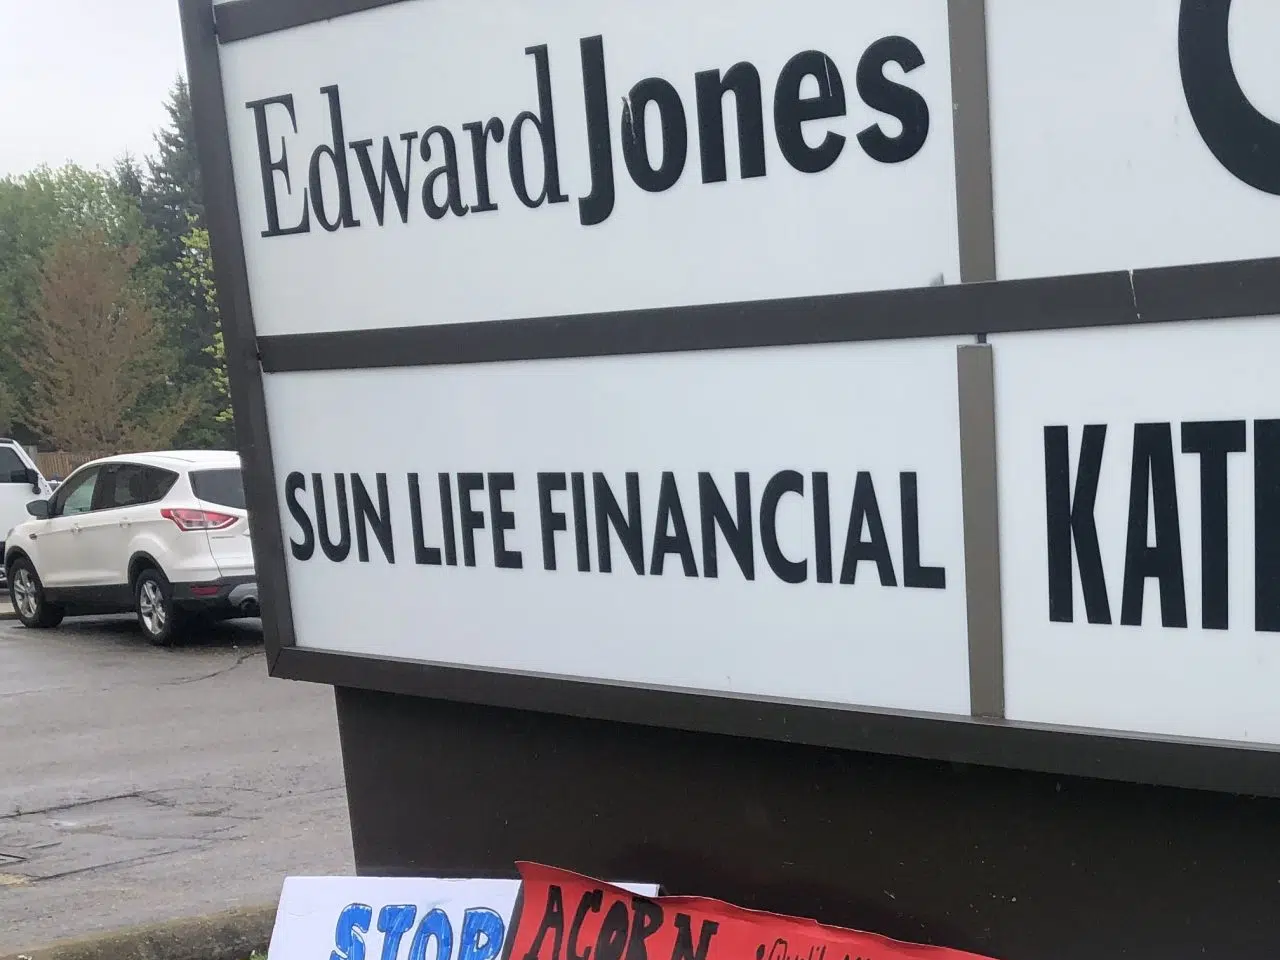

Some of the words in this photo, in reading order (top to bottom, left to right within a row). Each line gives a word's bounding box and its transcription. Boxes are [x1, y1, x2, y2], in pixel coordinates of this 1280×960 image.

[284, 471, 396, 565] SUN
[407, 472, 523, 570] LIFE
[537, 469, 947, 590] FINANCIAL
